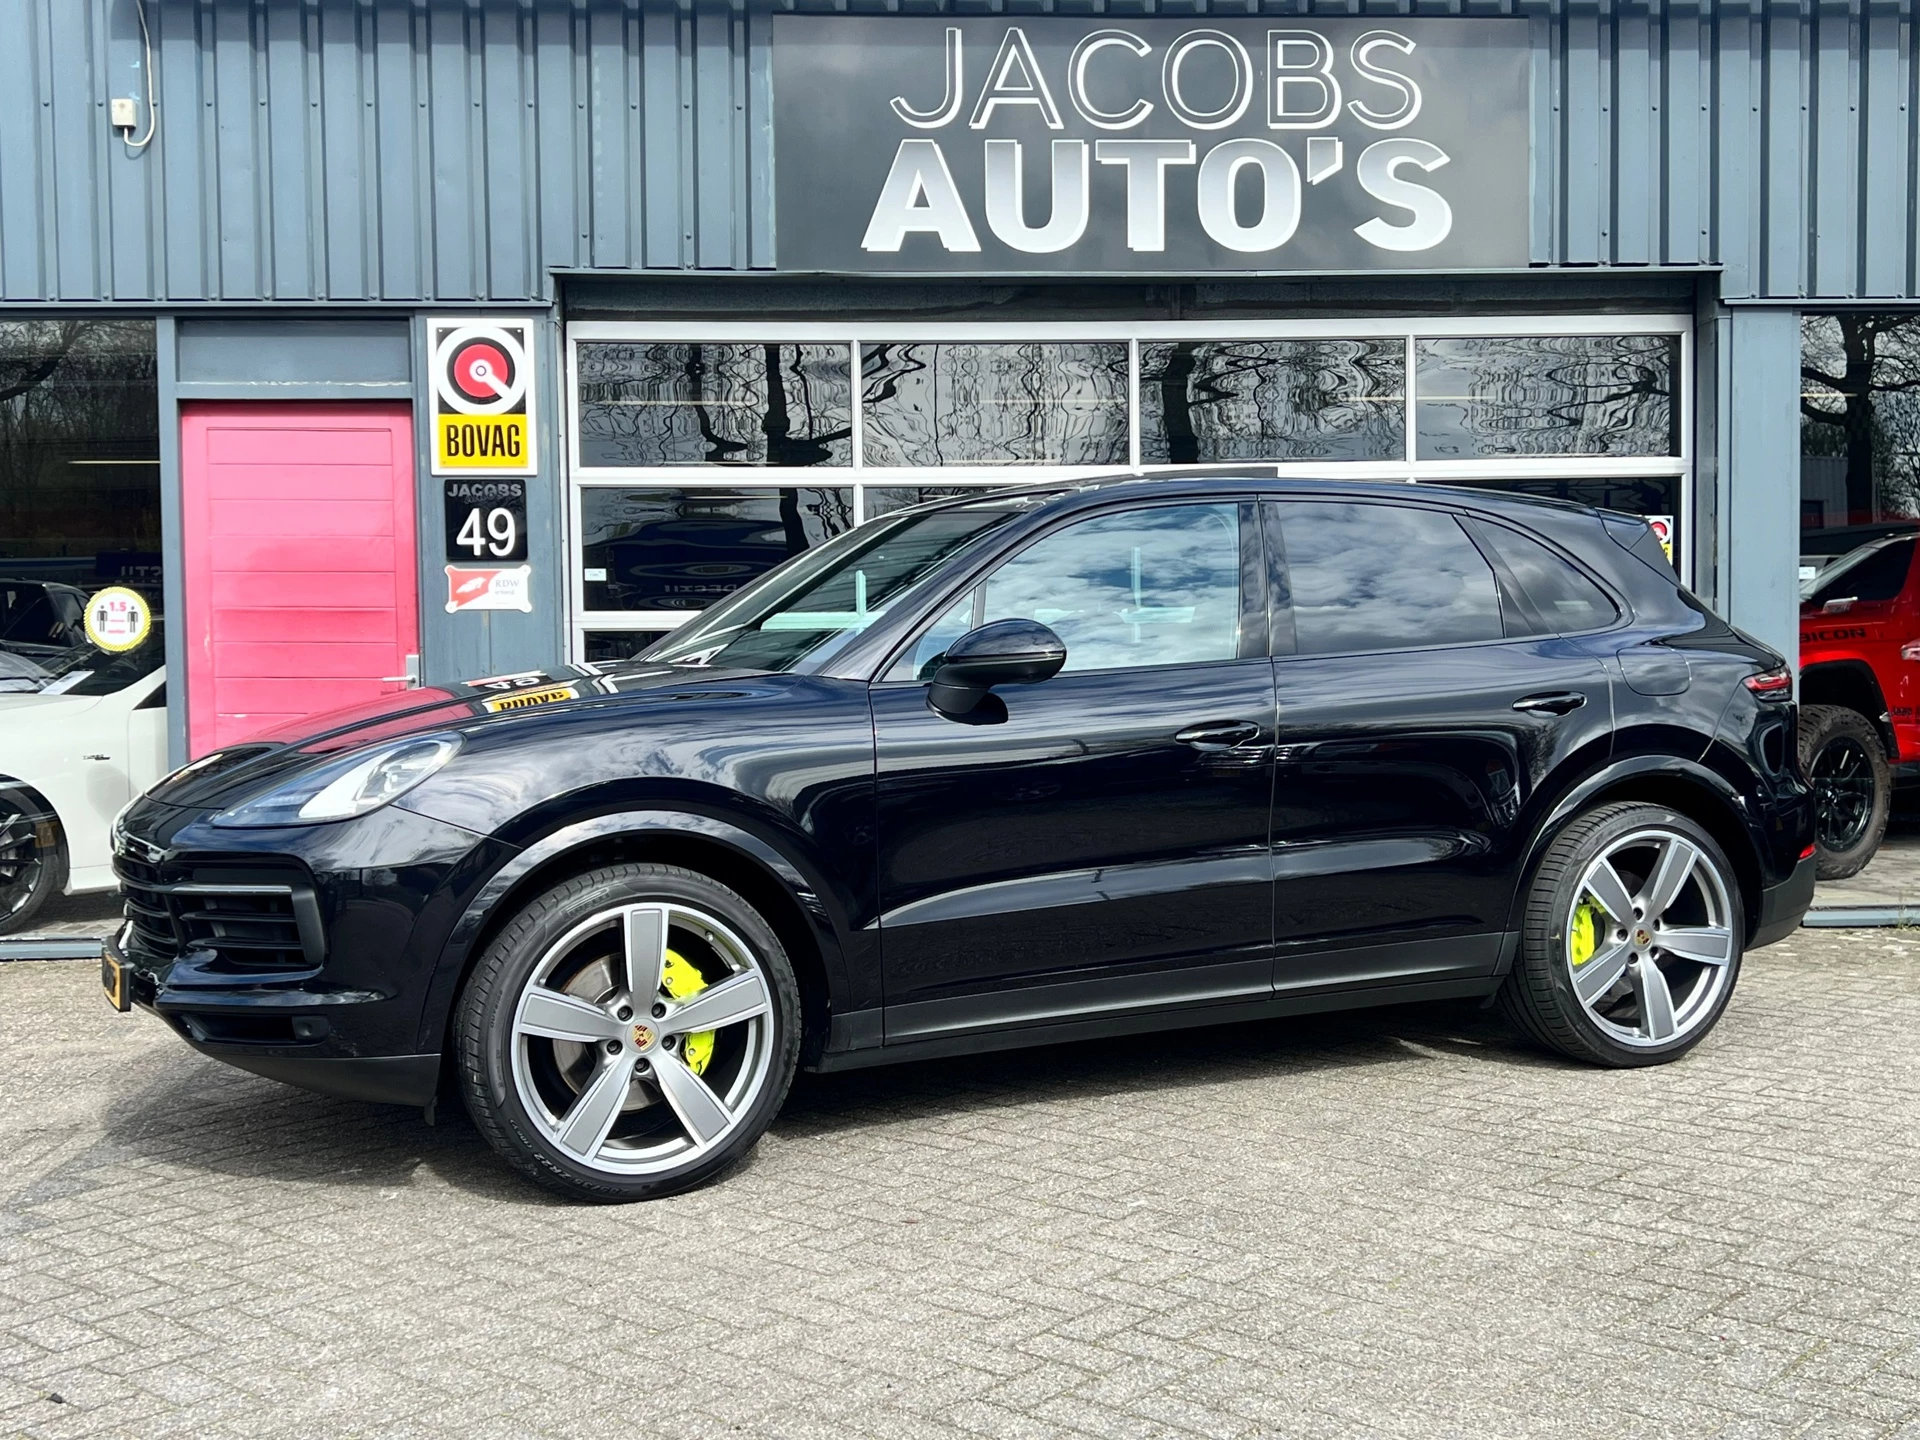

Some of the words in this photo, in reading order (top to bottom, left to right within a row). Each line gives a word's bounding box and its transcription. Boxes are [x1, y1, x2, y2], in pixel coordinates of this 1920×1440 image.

[889, 26, 1423, 131] JACOBS
[860, 136, 1453, 254] AUTO'S
[445, 423, 521, 458] BOVAG
[447, 483, 522, 498] JACOBS
[456, 507, 516, 557] 49
[495, 579, 520, 588] RDW
[109, 602, 127, 612] 1.5
